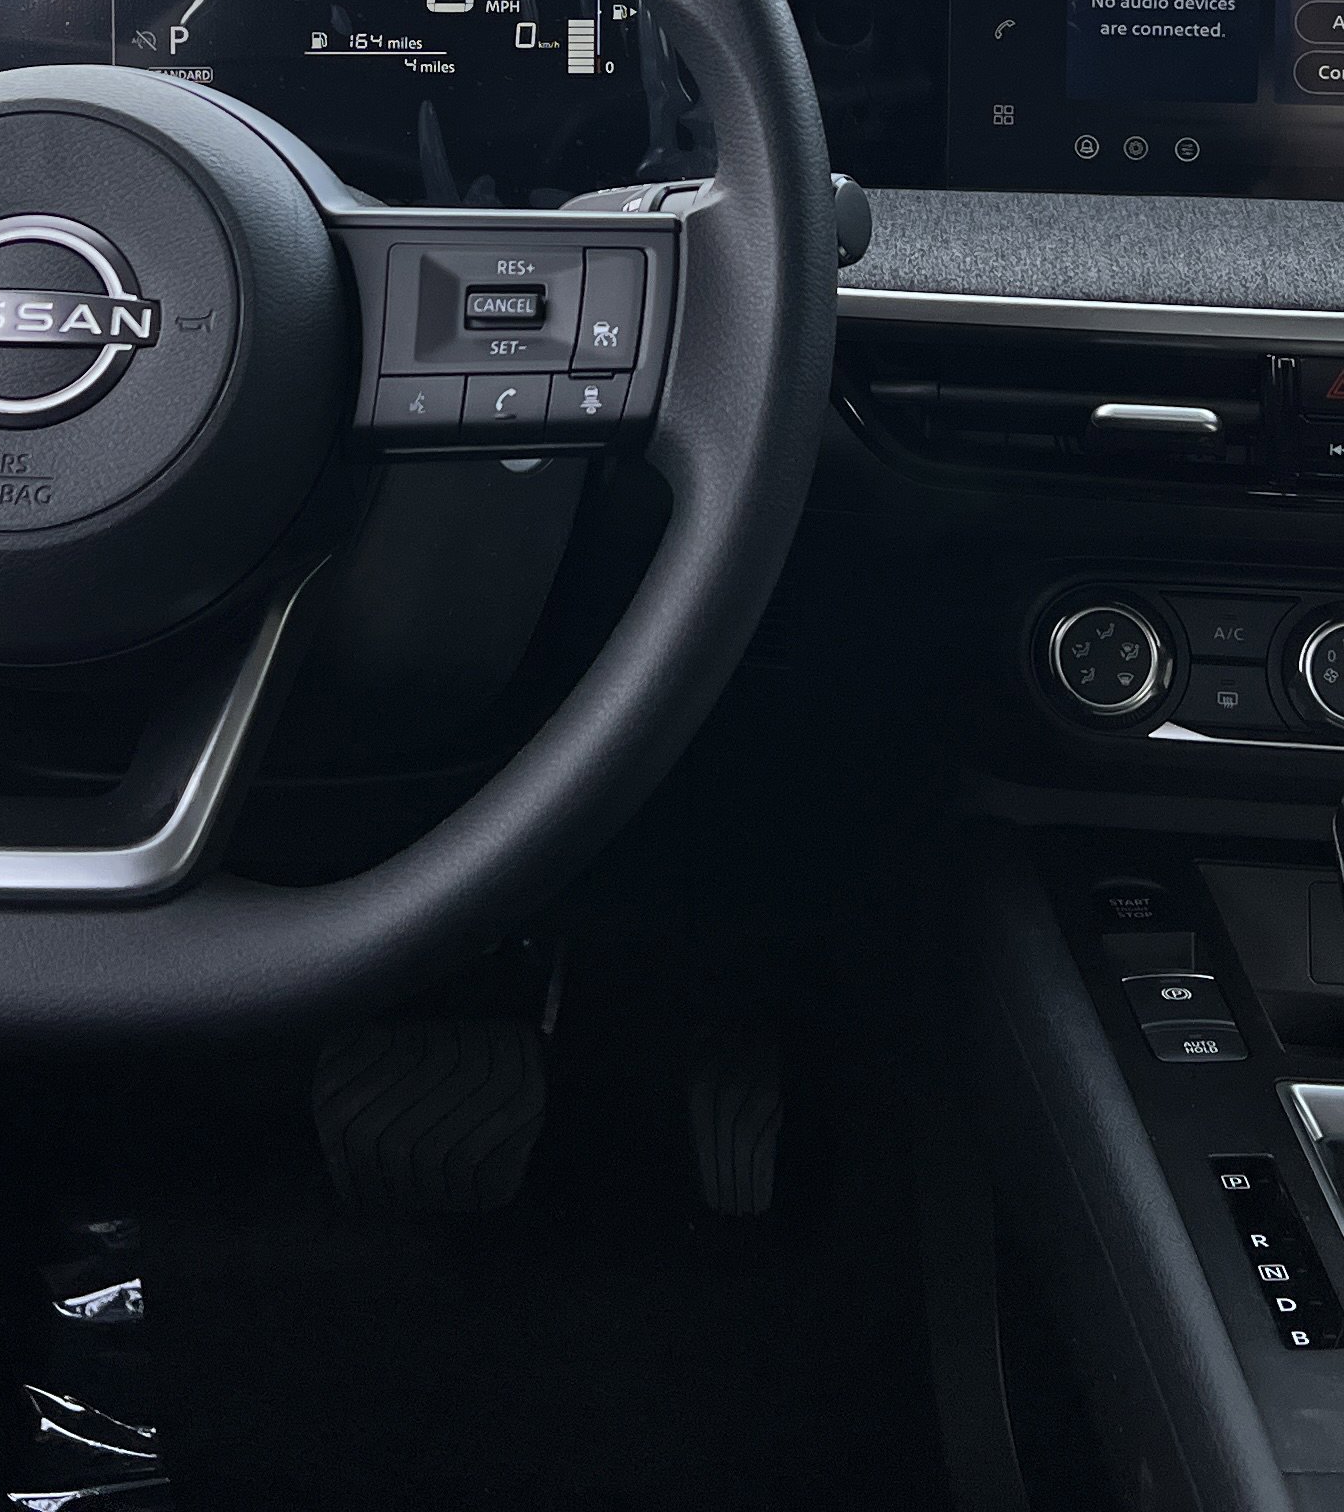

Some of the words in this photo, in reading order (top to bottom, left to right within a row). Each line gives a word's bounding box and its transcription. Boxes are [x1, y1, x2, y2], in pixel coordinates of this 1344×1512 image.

[485, 0, 521, 14] MPH
[1099, 24, 1128, 37] are
[1131, 20, 1227, 38] connected.
[170, 25, 190, 55] P
[349, 33, 384, 50] 164
[387, 35, 423, 50] miles
[538, 39, 560, 49] km/h
[404, 58, 418, 72] 4
[420, 59, 456, 74] miles
[605, 61, 615, 74] 0
[496, 260, 536, 275] RES+
[472, 298, 534, 314] CANCEL
[1213, 626, 1245, 641] A/C
[1327, 649, 1337, 663] 0
[1109, 898, 1151, 906] START
[1183, 1040, 1216, 1048] AUTO
[1185, 1046, 1219, 1054] HOLD
[1228, 1176, 1243, 1187] P
[1250, 1234, 1270, 1248] R
[1264, 1266, 1283, 1279] N
[1275, 1297, 1297, 1313] D
[1290, 1330, 1310, 1346] B
